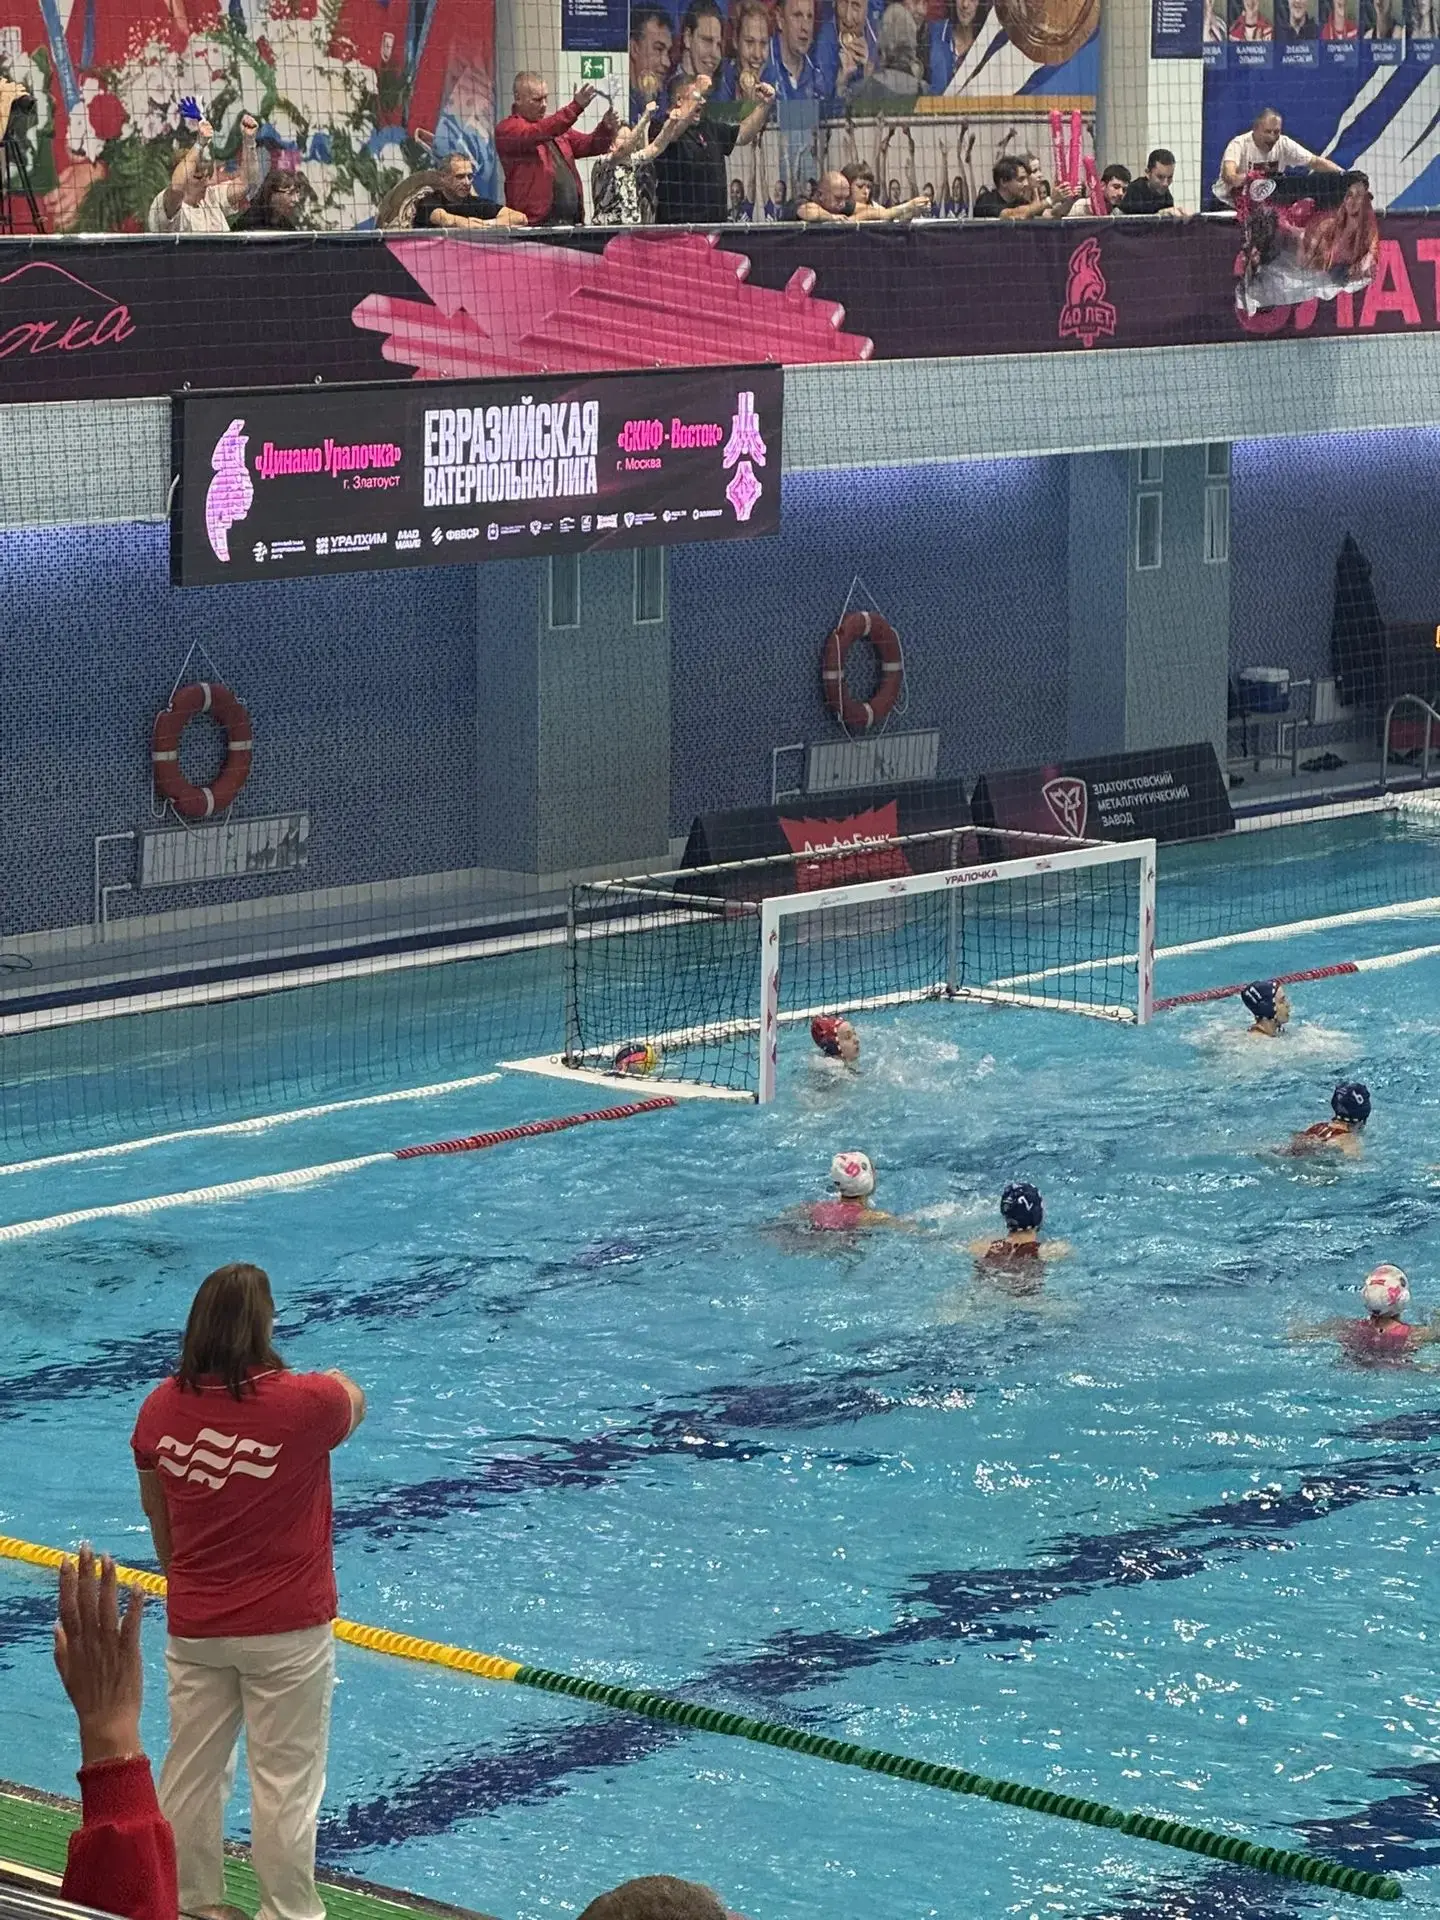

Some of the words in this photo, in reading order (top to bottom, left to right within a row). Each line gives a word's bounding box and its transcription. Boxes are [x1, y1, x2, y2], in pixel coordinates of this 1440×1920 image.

[1085, 306, 1111, 328] ЛЕТ
[424, 395, 599, 466] ЕВРАЗИЙСКАЯ
[617, 419, 664, 452] «СКИФ
[671, 417, 723, 449] Восток»
[255, 442, 323, 479] «Динамо
[323, 438, 402, 478] Уралочка»
[616, 460, 623, 471] г.
[625, 457, 662, 471] Москва
[343, 478, 350, 489] г.
[353, 474, 401, 490] Златоуст
[423, 459, 555, 507] ВАТЕРПОЛЬНАЯ
[555, 455, 598, 497] ЛИГА
[330, 532, 387, 548] УРАЛХИМ
[1092, 771, 1174, 795] ЗЛАТОУСТОВСКИЙ
[1097, 784, 1190, 811] МЕТАЛЛУРГИЧЕСКИЙ
[1101, 812, 1135, 827] ЗАВОД
[944, 868, 999, 885] УРАЛОЧКА
[1018, 1196, 1033, 1211] 2
